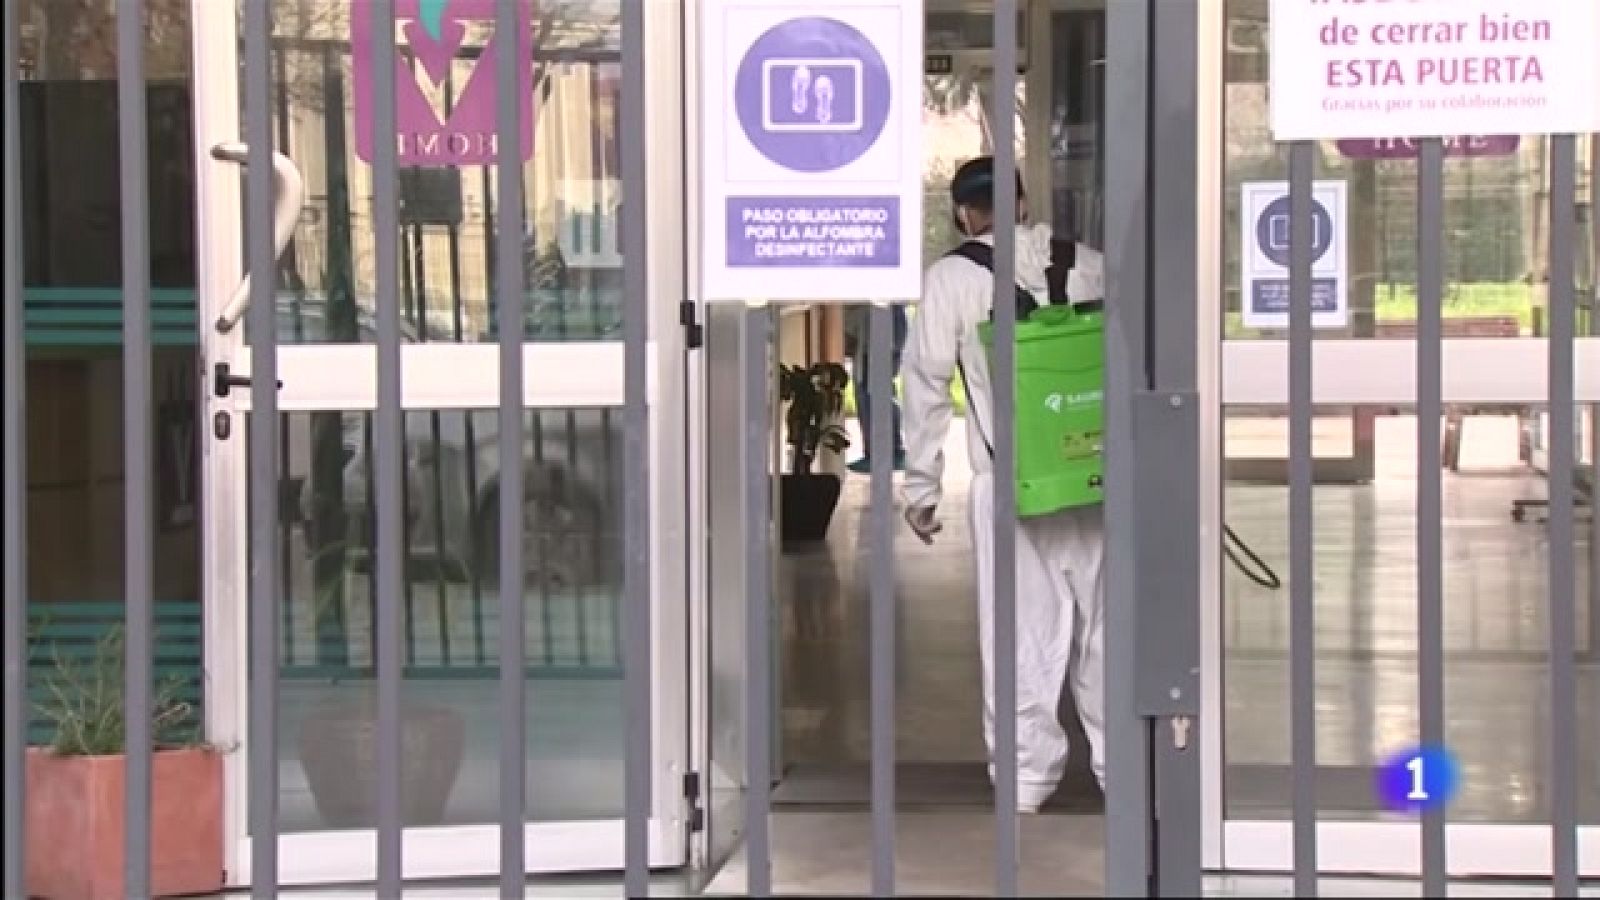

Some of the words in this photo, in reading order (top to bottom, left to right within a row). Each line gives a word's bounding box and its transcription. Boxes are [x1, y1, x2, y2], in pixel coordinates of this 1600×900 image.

[1319, 16, 1359, 45] de
[1370, 21, 1468, 45] cerrar
[1479, 12, 1551, 42] bien
[1326, 59, 1405, 88] ESTA
[1416, 55, 1544, 86] PUERTA
[1321, 97, 1381, 112] Gracias
[1384, 99, 1413, 114] por
[1419, 98, 1437, 110] su
[742, 208, 783, 223] PASO
[787, 208, 889, 223] OBLIGATORIO
[744, 224, 777, 240] POR
[780, 225, 799, 240] LA
[802, 224, 886, 240] ALFOMBRA
[754, 241, 877, 257] DESINFECTANTE
